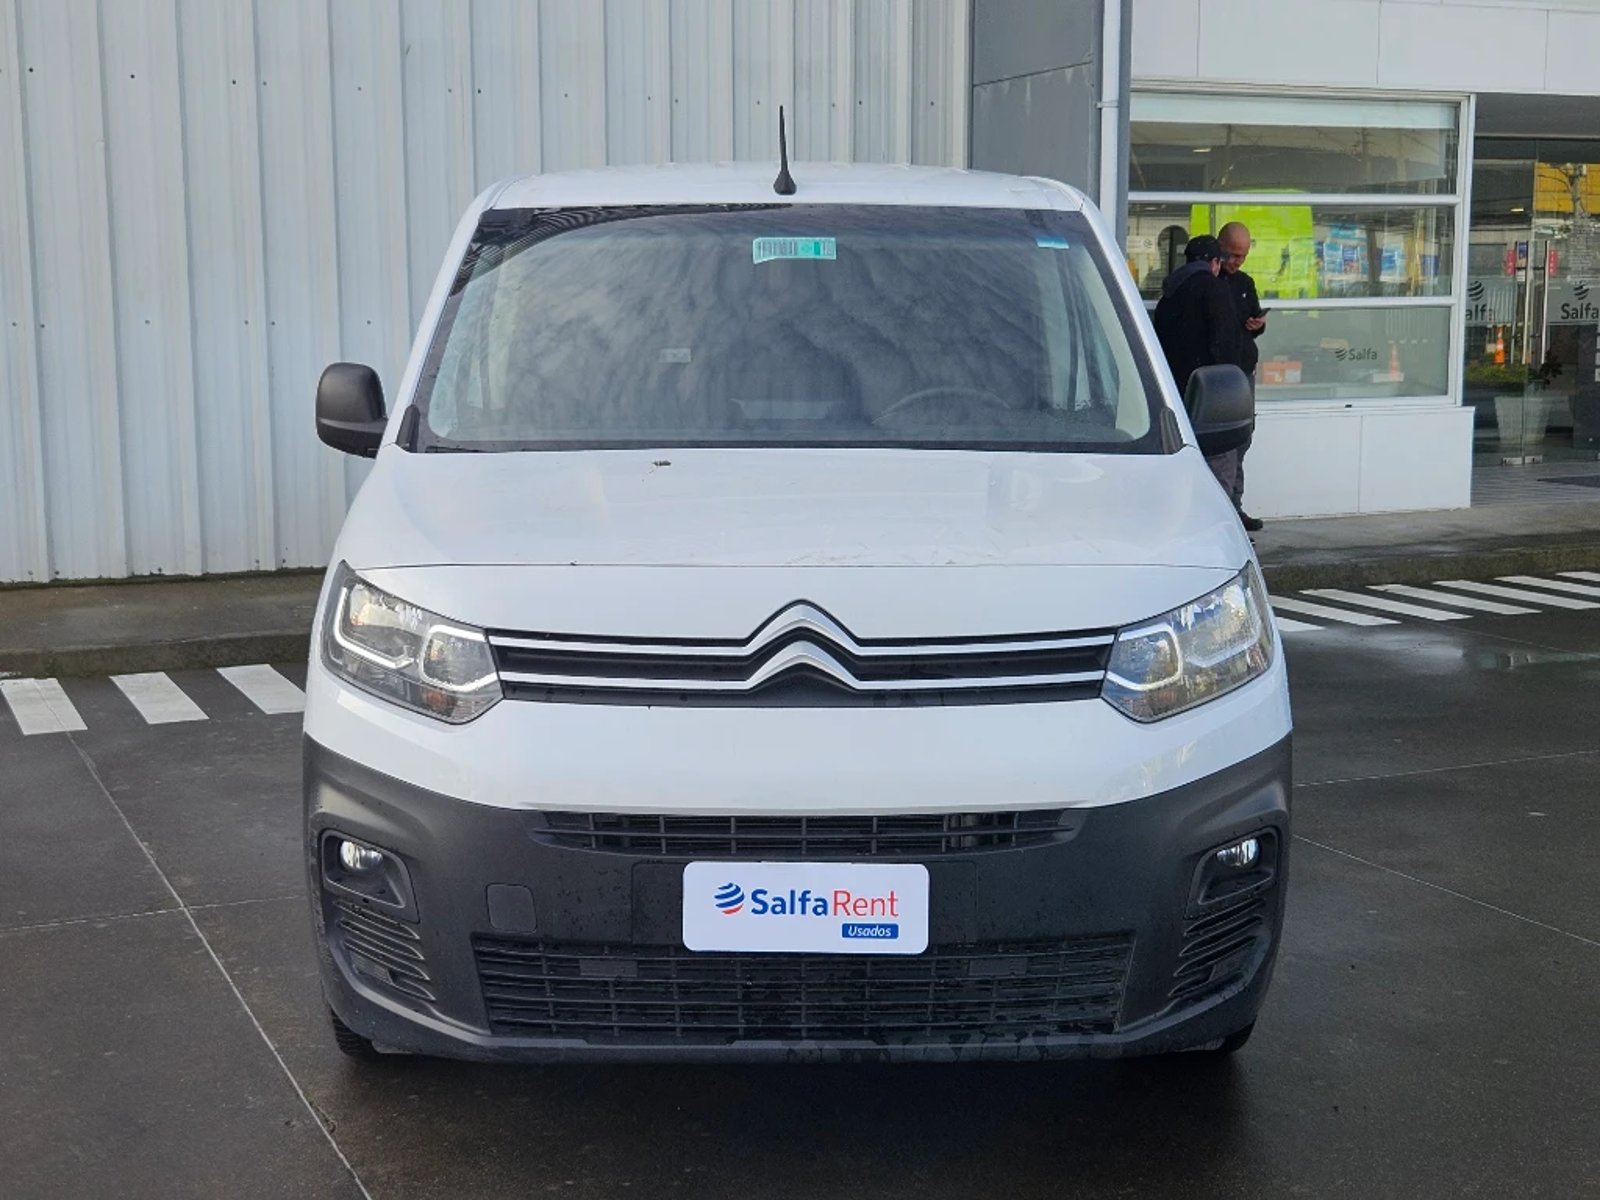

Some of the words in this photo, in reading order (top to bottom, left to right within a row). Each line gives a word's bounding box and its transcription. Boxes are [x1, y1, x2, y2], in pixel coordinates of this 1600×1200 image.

[1465, 302, 1496, 320] alfa
[1560, 302, 1599, 320] Salfa
[1348, 347, 1378, 361] Salfa
[848, 925, 892, 937] Usados
